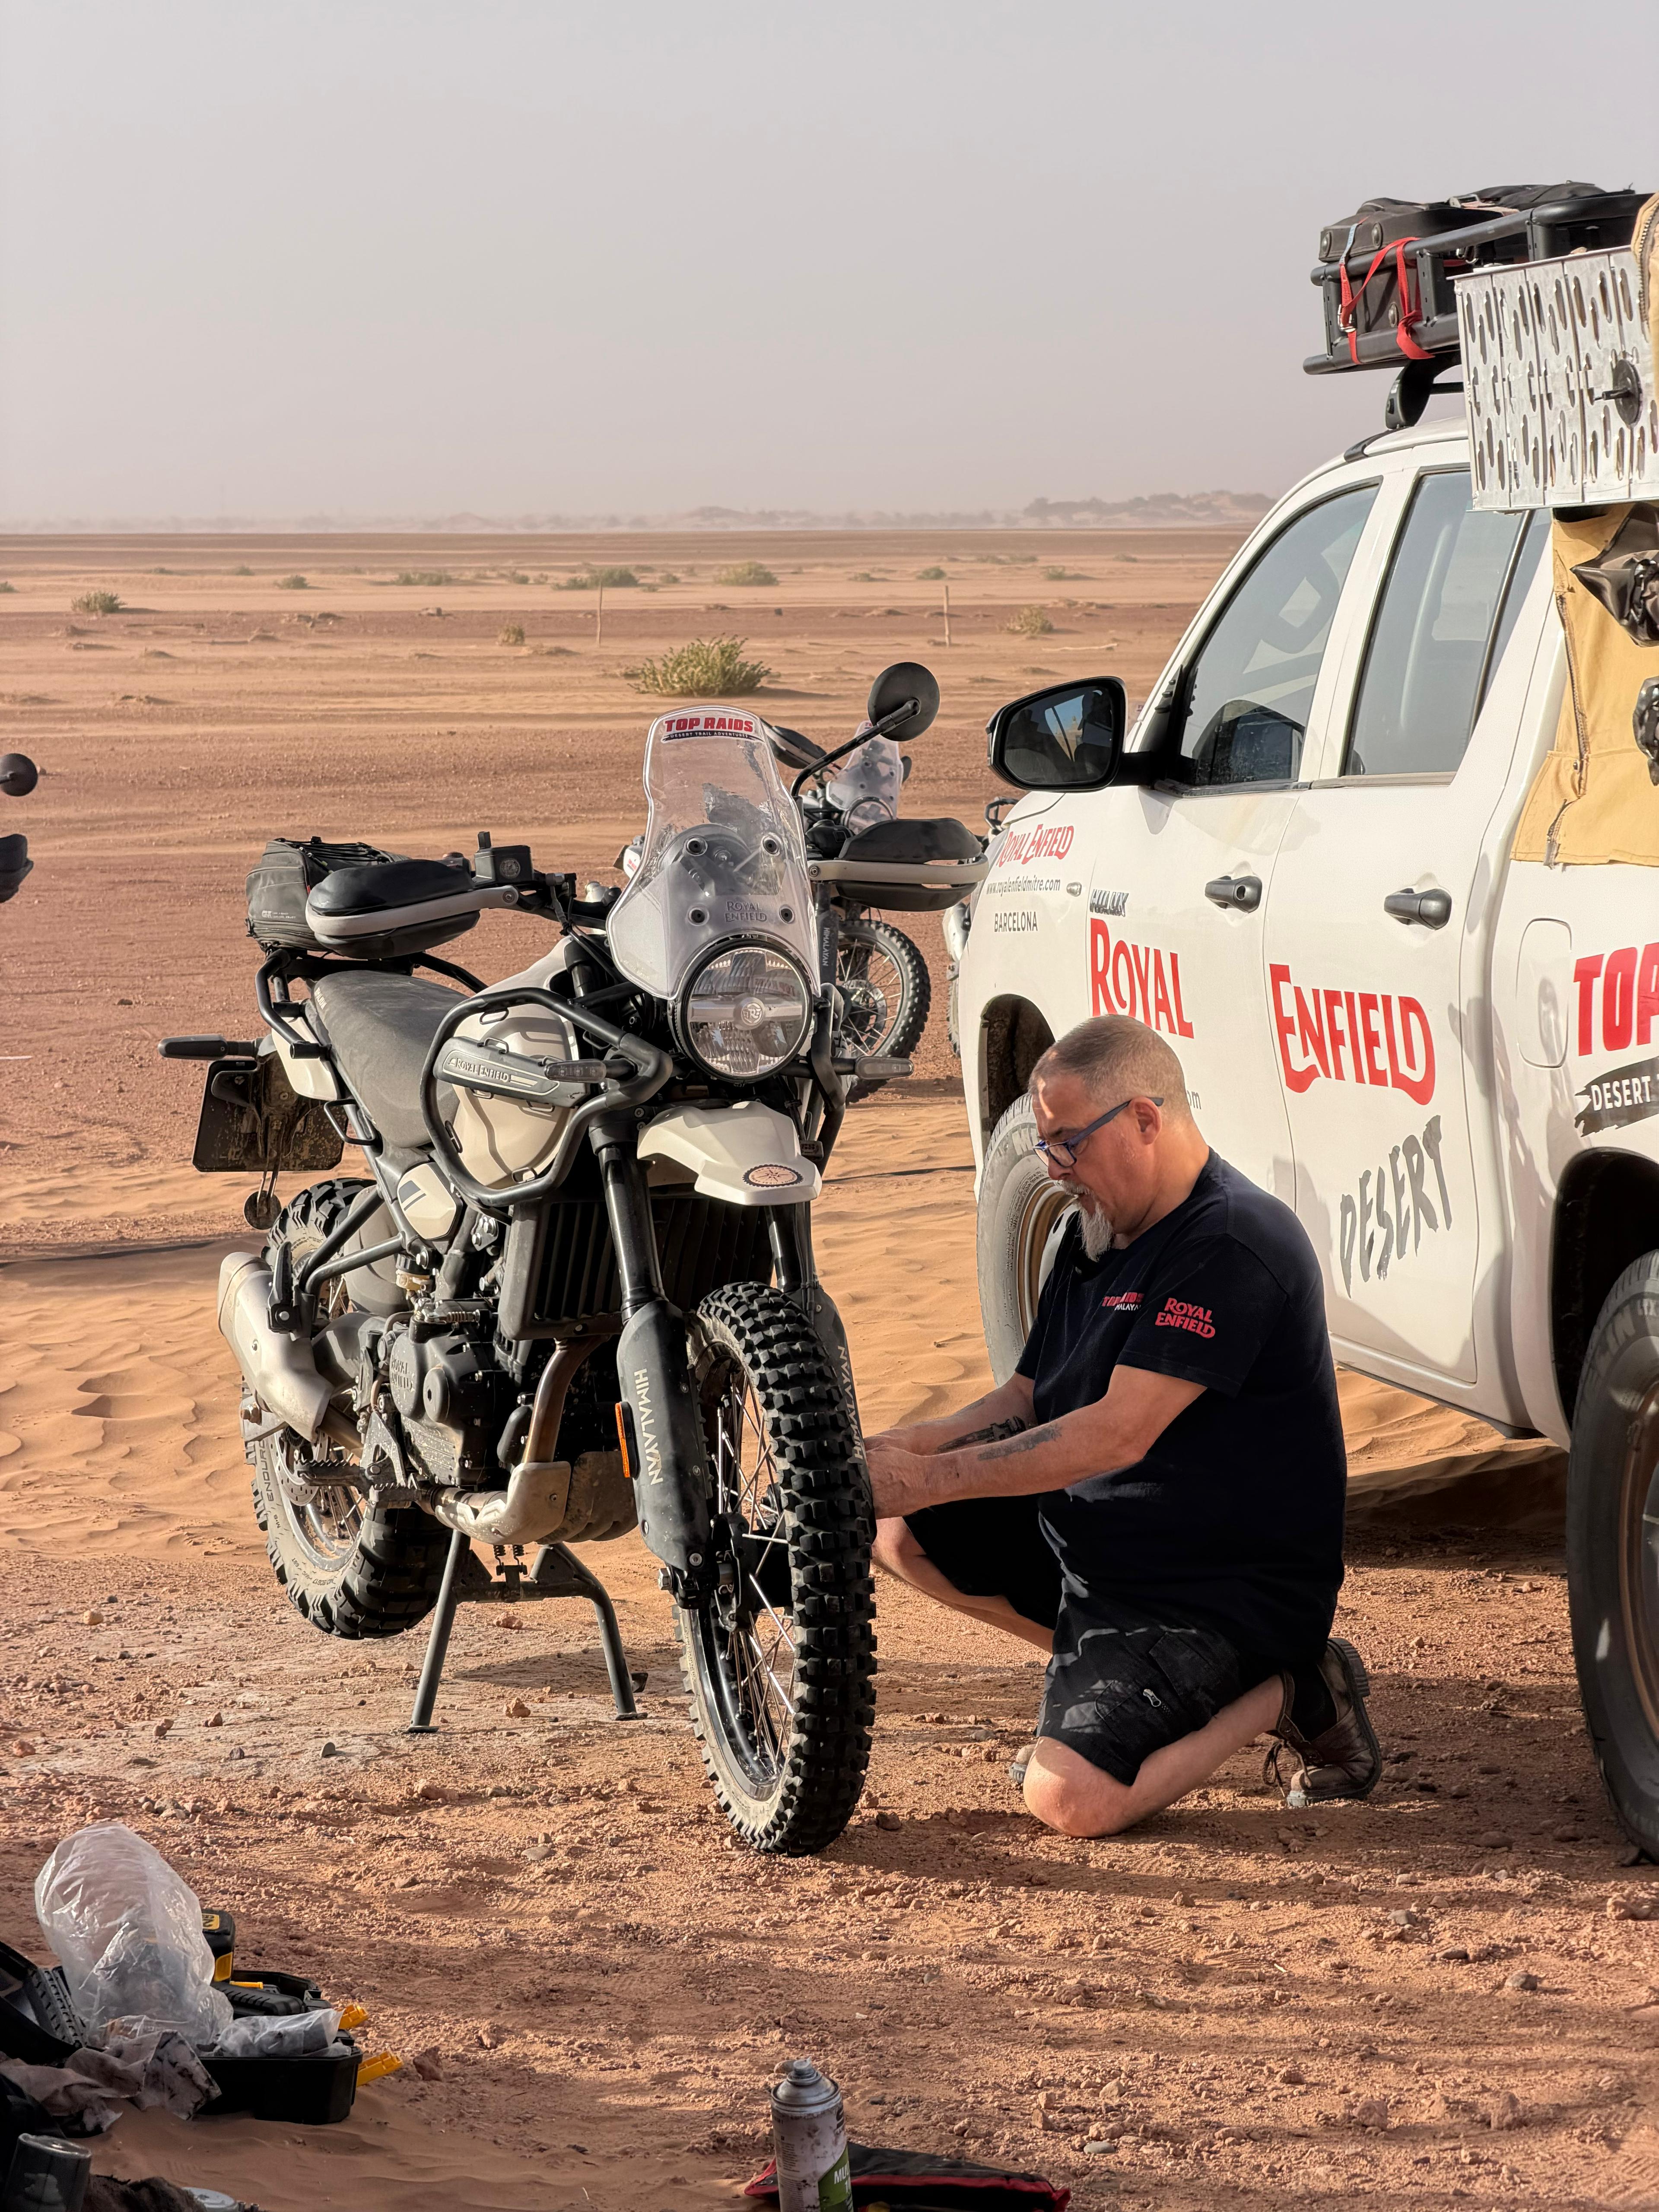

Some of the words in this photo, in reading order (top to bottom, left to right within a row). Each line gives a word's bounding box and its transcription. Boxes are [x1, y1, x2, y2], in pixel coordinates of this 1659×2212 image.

[664, 717, 700, 732] TOP
[704, 717, 753, 732] RAIDS
[995, 831, 1032, 868] ROYAL
[1021, 823, 1074, 864] ENFIELD
[724, 912, 767, 922] ENFIELD
[726, 901, 762, 911] ROYAL
[994, 911, 1038, 932] BARCELONA
[822, 927, 830, 966] HIMALAYAN
[1090, 918, 1195, 1039] ROYAL
[1269, 963, 1436, 1106] ENFIELD
[456, 1058, 478, 1074] ROYAL
[478, 1064, 509, 1083] ENFIELD
[1590, 1075, 1651, 1111] DESERT
[1340, 1115, 1452, 1299] DESERT
[1155, 1312, 1216, 1338] ENFIELD
[1164, 1297, 1213, 1323] ROYAL
[633, 1368, 664, 1486] HIMALAYAN
